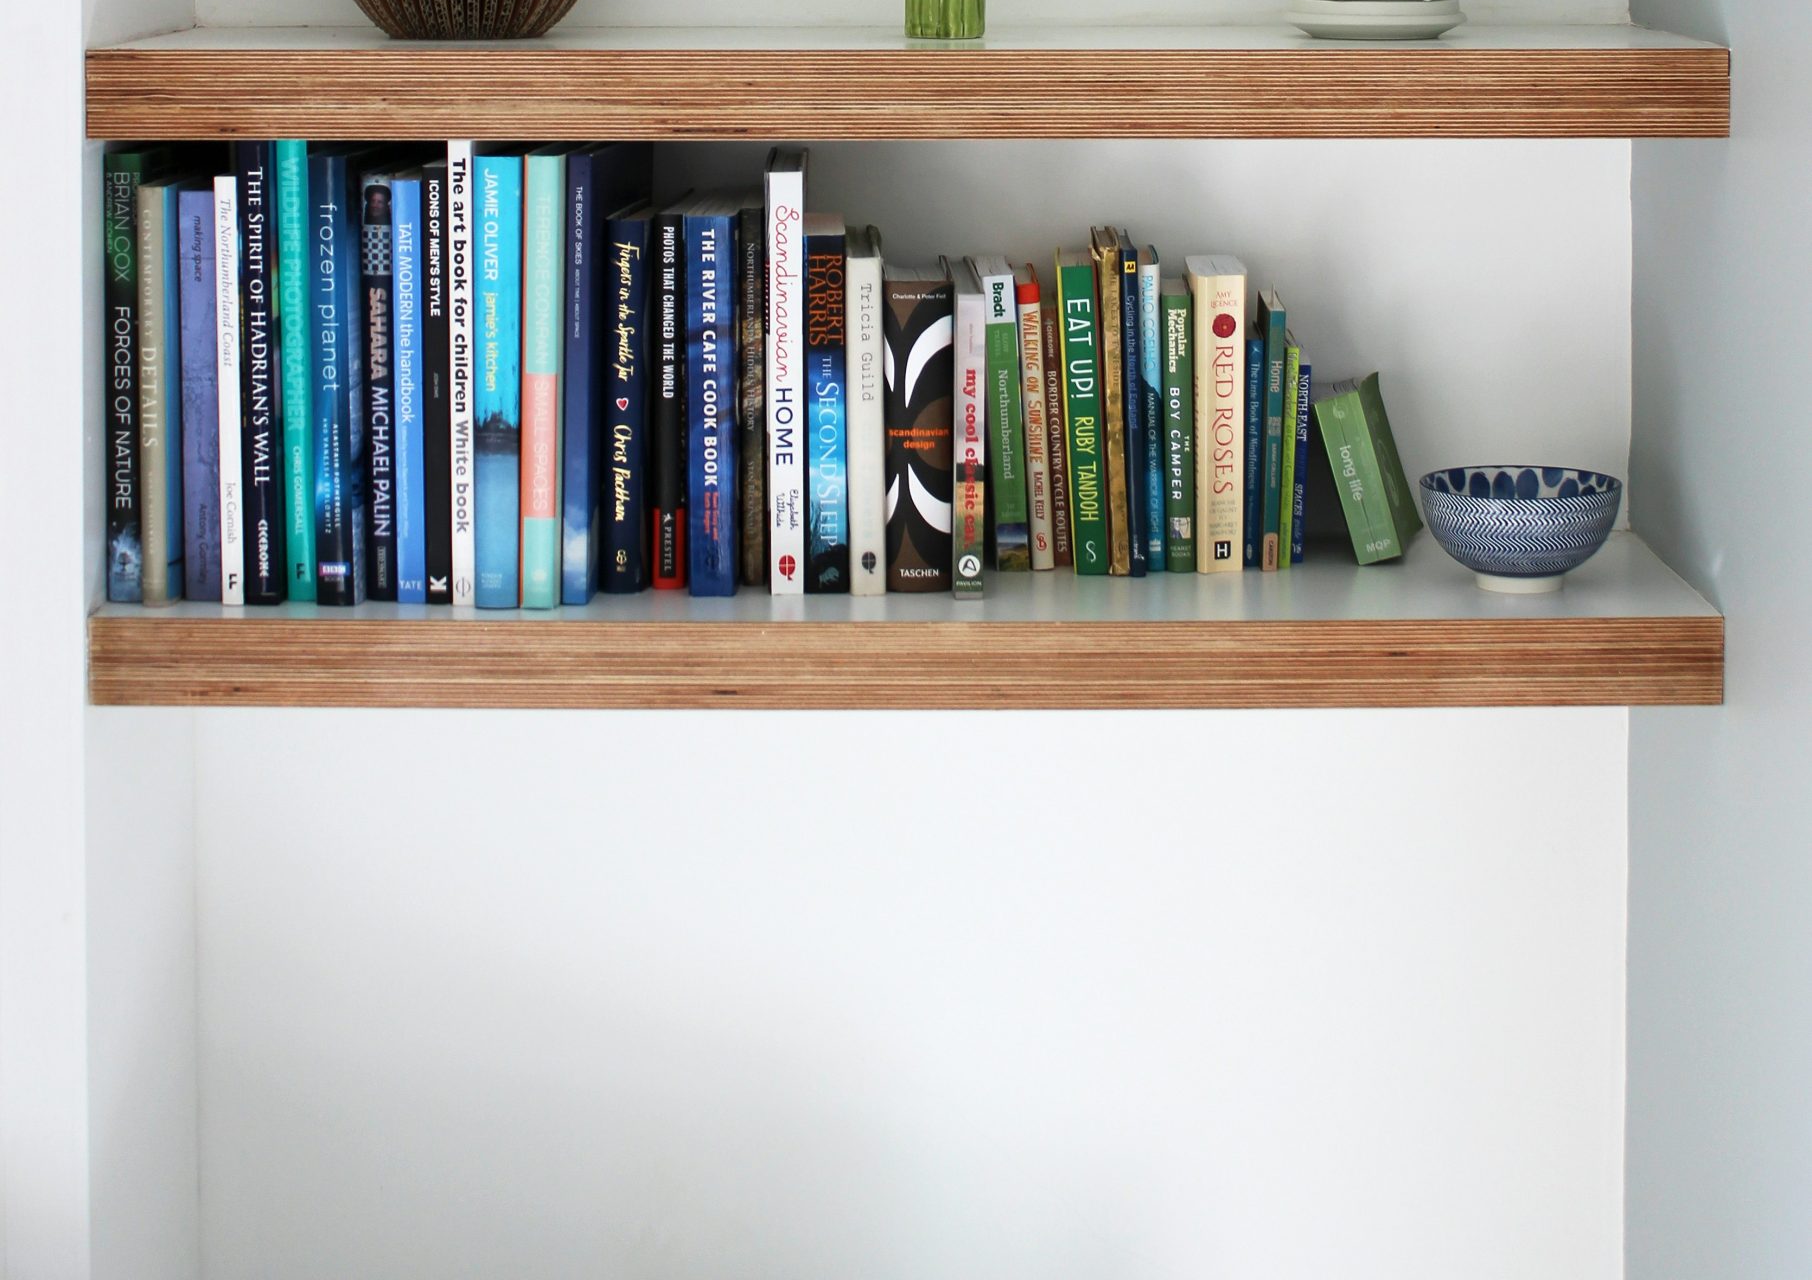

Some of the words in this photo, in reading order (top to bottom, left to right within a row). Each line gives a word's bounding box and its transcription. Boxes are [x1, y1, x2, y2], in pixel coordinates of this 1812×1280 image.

[247, 166, 263, 206] THE
[452, 157, 467, 195] The
[483, 168, 499, 218] JAMIE
[575, 186, 583, 202] THE
[113, 171, 131, 230] BRIAN
[219, 199, 231, 221] The
[280, 159, 301, 253] WILDLIFE
[429, 179, 441, 218] ICONS
[453, 201, 467, 233] art
[575, 203, 583, 227] BOOK
[191, 215, 202, 252] making
[248, 213, 265, 273] SPIRIT
[319, 202, 338, 292] frozen
[399, 222, 413, 253] TATE
[430, 220, 441, 237] OF
[535, 195, 552, 281] TERENCE
[575, 228, 583, 240] OF
[662, 225, 675, 264] PHOTOS
[702, 228, 716, 263] THE
[113, 236, 131, 282] COX
[191, 254, 202, 282] space
[430, 238, 442, 276] MEN'S
[453, 239, 469, 291] book
[484, 221, 499, 281] OLIVER
[574, 241, 583, 266] SKIES
[612, 241, 640, 286] Fingers
[142, 209, 153, 337] CONTEMPORARY
[220, 225, 234, 328] Northumberland
[249, 279, 264, 304] OF
[399, 255, 414, 320] MODERN
[662, 267, 675, 290] THAT
[430, 277, 442, 317] STYLE
[454, 297, 469, 328] for
[616, 287, 631, 301] in
[618, 303, 636, 320] the
[702, 269, 717, 324] RIVER
[775, 205, 800, 383] Scandinavian
[808, 255, 827, 346] HARRIS
[825, 255, 843, 345] ROBERT
[860, 282, 873, 342] Tricia
[992, 282, 1005, 318] Bradt
[1126, 295, 1136, 328] Cycling
[1142, 275, 1154, 314] PAULO
[369, 287, 388, 380] SAHARA
[400, 323, 414, 347] the
[482, 292, 499, 338] jamie's
[535, 285, 551, 365] CONRAN
[662, 294, 675, 339] CHANGED
[1066, 299, 1092, 346] EAT
[1177, 308, 1187, 358] Popular
[114, 306, 131, 389] FORCES
[222, 332, 235, 368] Coast
[283, 259, 306, 432] PHOTOGRAPHER
[320, 304, 340, 391] planet
[613, 322, 636, 363] Sparkle
[662, 343, 675, 361] THE
[703, 329, 717, 373] CAFE
[1022, 311, 1041, 370] WALKING
[1128, 338, 1136, 353] the
[1143, 318, 1156, 370] COELHO
[1167, 308, 1179, 374] Mechanics
[251, 311, 269, 425] HADRIAN'S
[400, 349, 416, 423] handbook
[454, 333, 471, 413] children
[484, 342, 500, 392] kitchen
[612, 364, 634, 383] Jar
[662, 364, 675, 399] WORLD
[746, 346, 756, 385] HIDDEN
[821, 357, 833, 380] THE
[861, 352, 874, 402] Guild
[962, 368, 977, 397] my
[1026, 376, 1039, 393] ON
[1069, 360, 1094, 398] UP!
[1129, 355, 1138, 377] North
[1129, 380, 1137, 389] of
[1212, 346, 1233, 399] RED
[1250, 362, 1261, 378] The
[1269, 360, 1283, 393] Home
[114, 396, 131, 424] OF
[141, 347, 158, 448] DETAILS
[533, 381, 549, 438] SMALL
[703, 379, 718, 429] COOK
[746, 388, 756, 432] HISTORY
[1046, 370, 1061, 415] BORDER
[1128, 392, 1139, 429] England
[1147, 392, 1156, 430] MANUAL
[1168, 387, 1181, 421] BOY
[1249, 401, 1260, 423] Book
[371, 386, 389, 476] MICHAEL
[613, 424, 633, 463] Chris
[775, 388, 794, 466] HOME
[815, 381, 839, 479] SECOND
[889, 428, 949, 437] scandinavian
[964, 403, 979, 443] cool
[997, 369, 1015, 479] Northumberland
[1027, 400, 1045, 464] SUNSHINE
[1074, 416, 1096, 455] RUBY
[1149, 431, 1156, 441] OF
[1249, 425, 1259, 435] of
[253, 431, 271, 487] WALL
[292, 446, 303, 475] CHRIS
[455, 420, 471, 476] White
[703, 436, 719, 487] BOOK
[903, 439, 936, 450] design
[1049, 418, 1064, 470] COUNTRY
[1149, 443, 1157, 458] THE
[1212, 408, 1236, 494] ROSES
[1247, 437, 1258, 490] Mindfulness
[1339, 445, 1356, 478] long
[115, 431, 132, 509] NATURE
[531, 442, 549, 513] SPACES
[964, 447, 979, 510] classic
[1033, 471, 1045, 497] RACHEL
[1170, 430, 1183, 501] CAMPER
[225, 482, 237, 499] Joe
[373, 479, 391, 537] PALIN
[456, 483, 471, 534] book
[612, 466, 632, 522] Packham
[789, 488, 799, 531] Elizabeth
[1034, 499, 1046, 520] KELLY
[1053, 474, 1066, 507] CYCLE
[1077, 461, 1100, 521] TANDOH
[1151, 497, 1158, 508] OF
[1293, 483, 1304, 516] SPACES
[1347, 479, 1364, 502] life
[226, 501, 238, 544] Cornish
[819, 483, 841, 548] SLEEP
[1055, 511, 1068, 553] ROUTES
[664, 526, 673, 572] PRESTEL
[1217, 543, 1228, 558] H
[1366, 539, 1392, 553] MQP
[400, 580, 422, 590] TATE
[900, 568, 939, 578] TASCHEN
